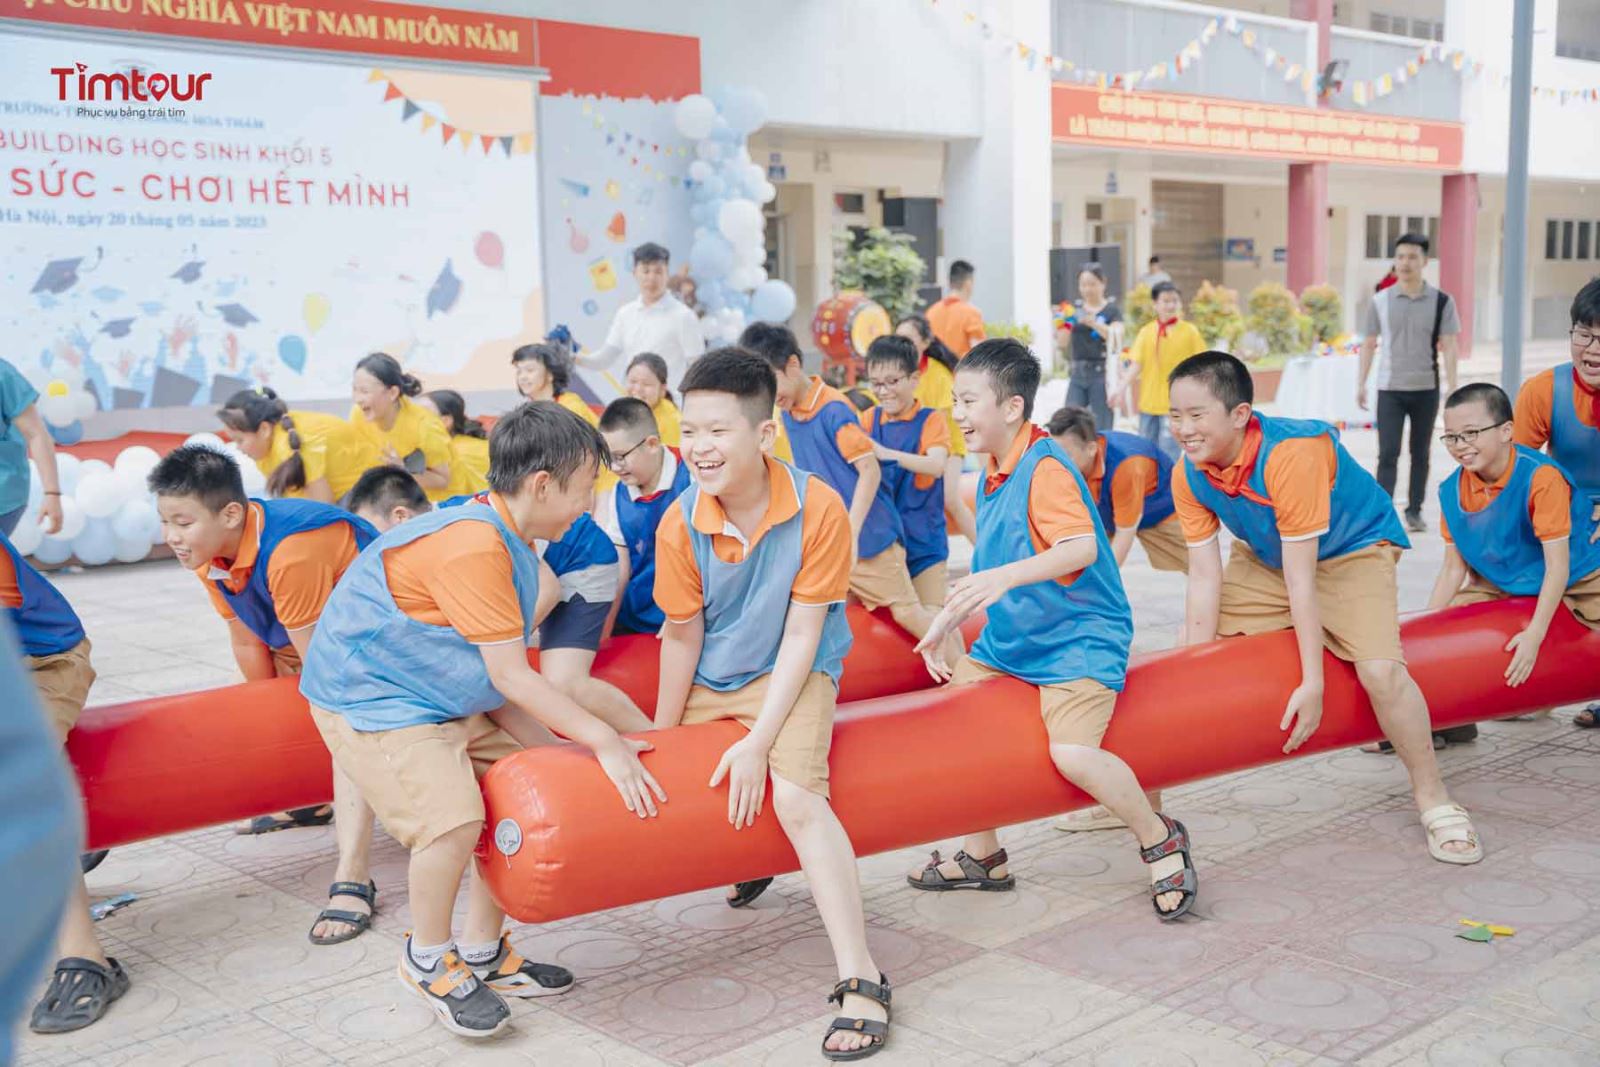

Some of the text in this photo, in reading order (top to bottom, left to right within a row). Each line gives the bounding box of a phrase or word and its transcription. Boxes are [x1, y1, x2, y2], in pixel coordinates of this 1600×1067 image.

[243, 2, 311, 36] VIỆT
[316, 10, 378, 39] NAM
[384, 15, 459, 46] MUÔN
[465, 23, 519, 53] NĂM
[194, 142, 250, 161] SINH
[320, 146, 333, 166] 5
[10, 159, 97, 198] SỨC
[141, 174, 233, 203] CHƠI
[249, 164, 315, 206] HẾT
[327, 172, 410, 208] MÌNH
